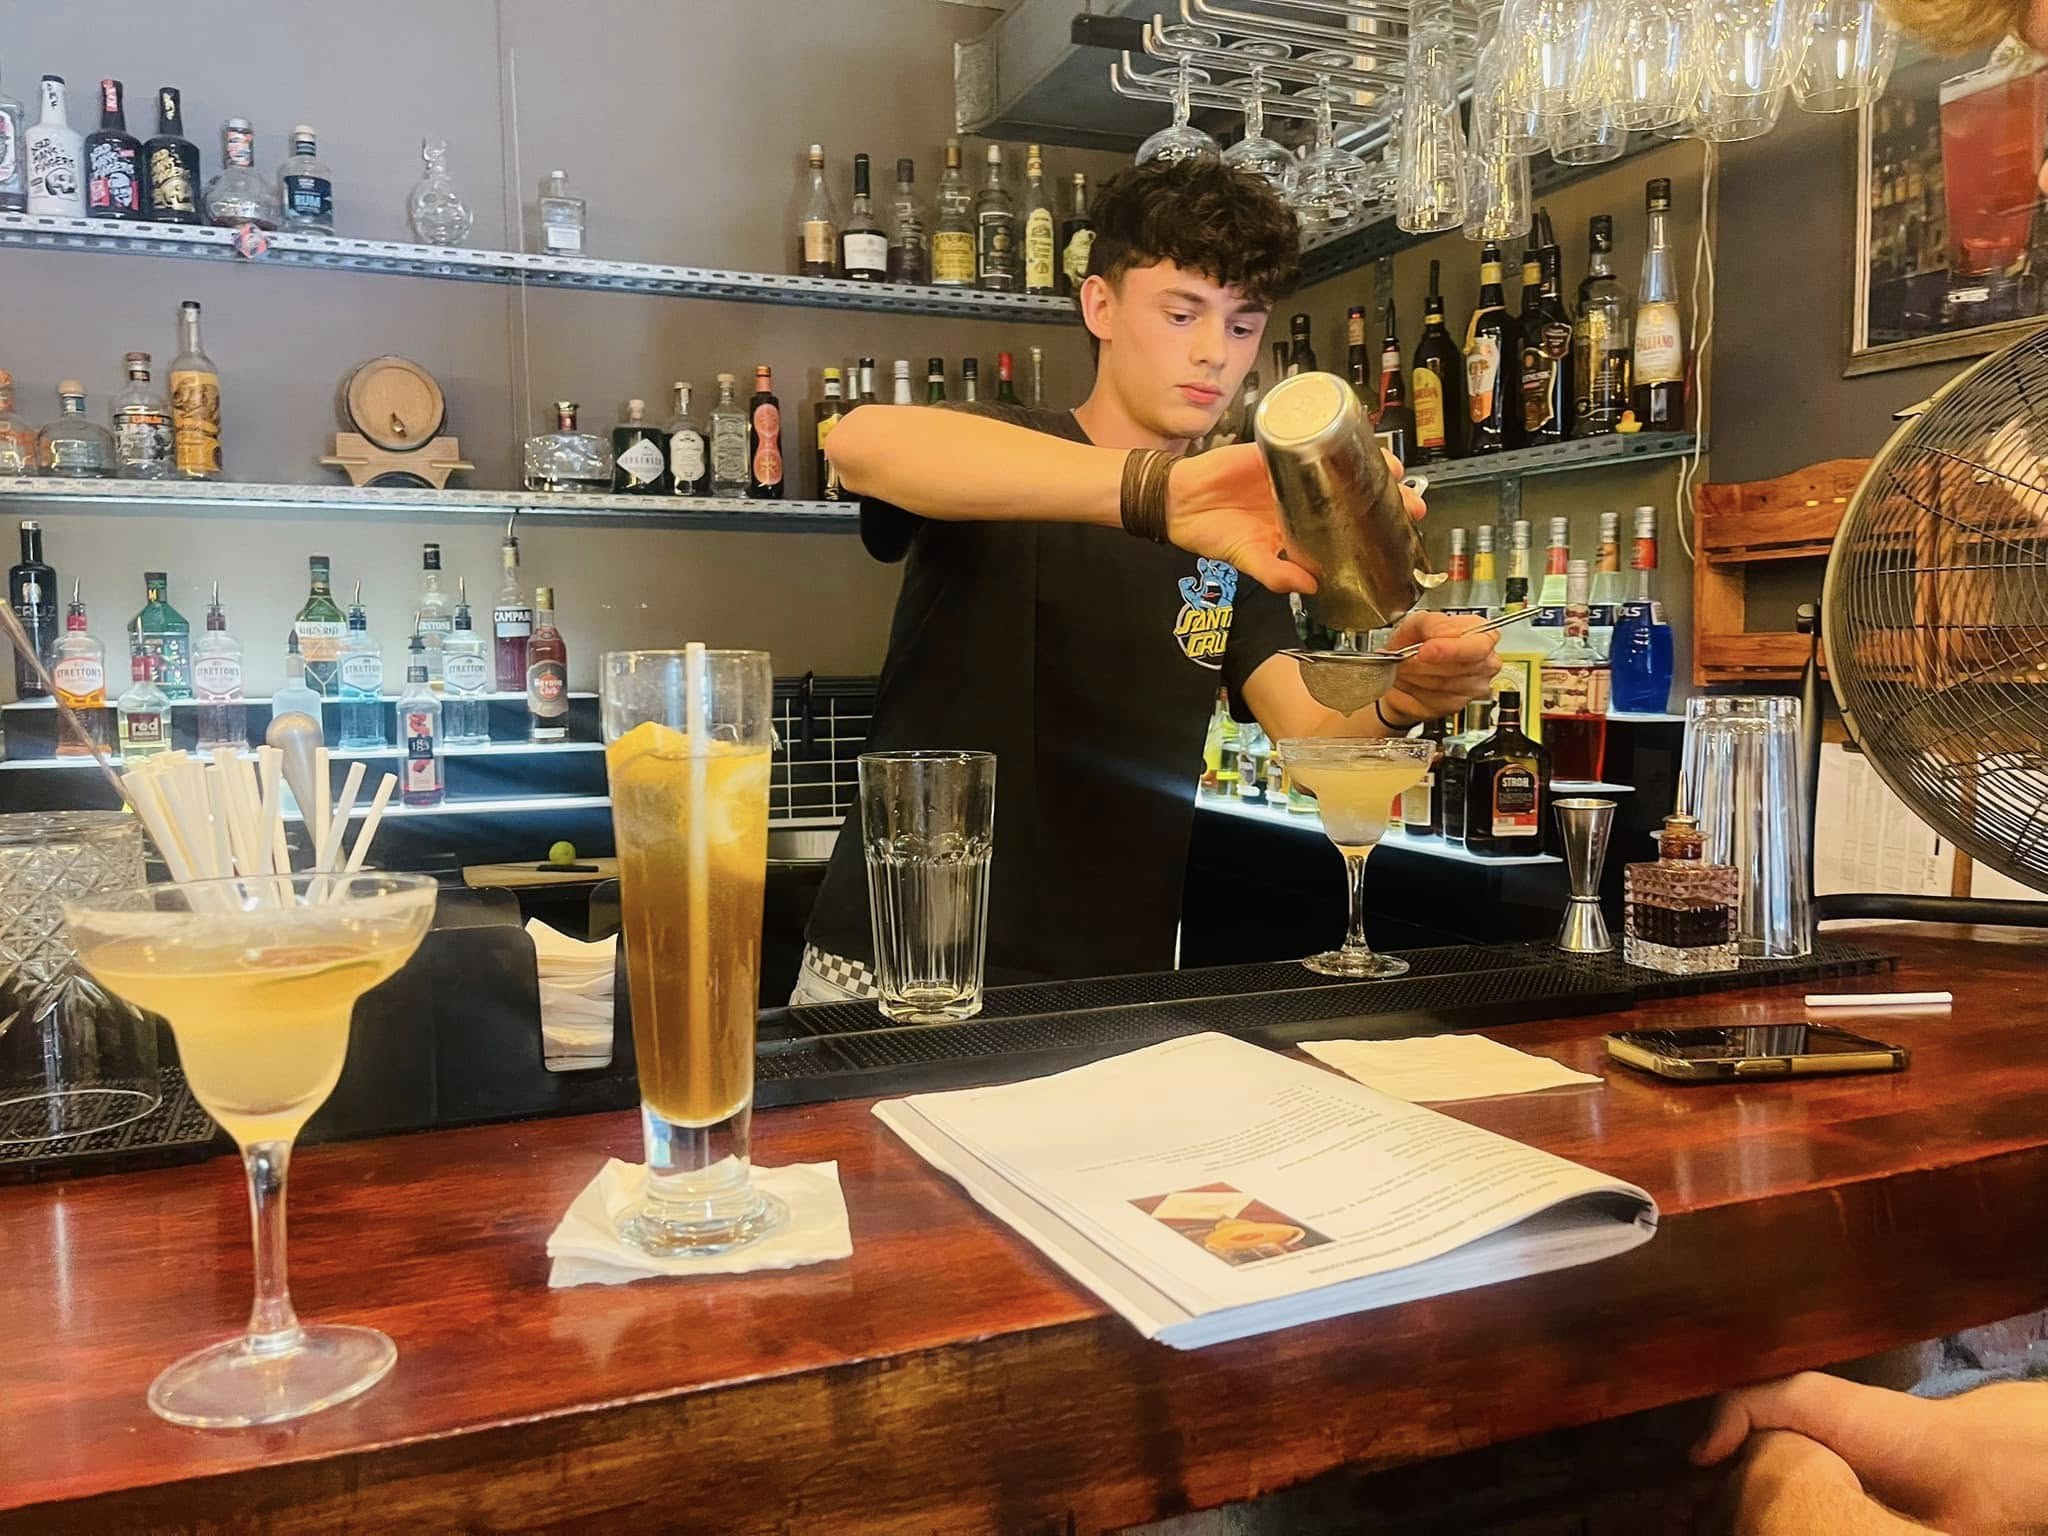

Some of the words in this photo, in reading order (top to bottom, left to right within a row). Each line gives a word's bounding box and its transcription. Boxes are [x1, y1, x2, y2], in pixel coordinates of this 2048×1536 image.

[294, 194, 321, 208] RUM
[494, 610, 531, 621] CAMPAR
[1616, 605, 1642, 617] OLS
[1174, 607, 1234, 635] SANT
[1187, 631, 1229, 658] CRU
[132, 717, 159, 732] red
